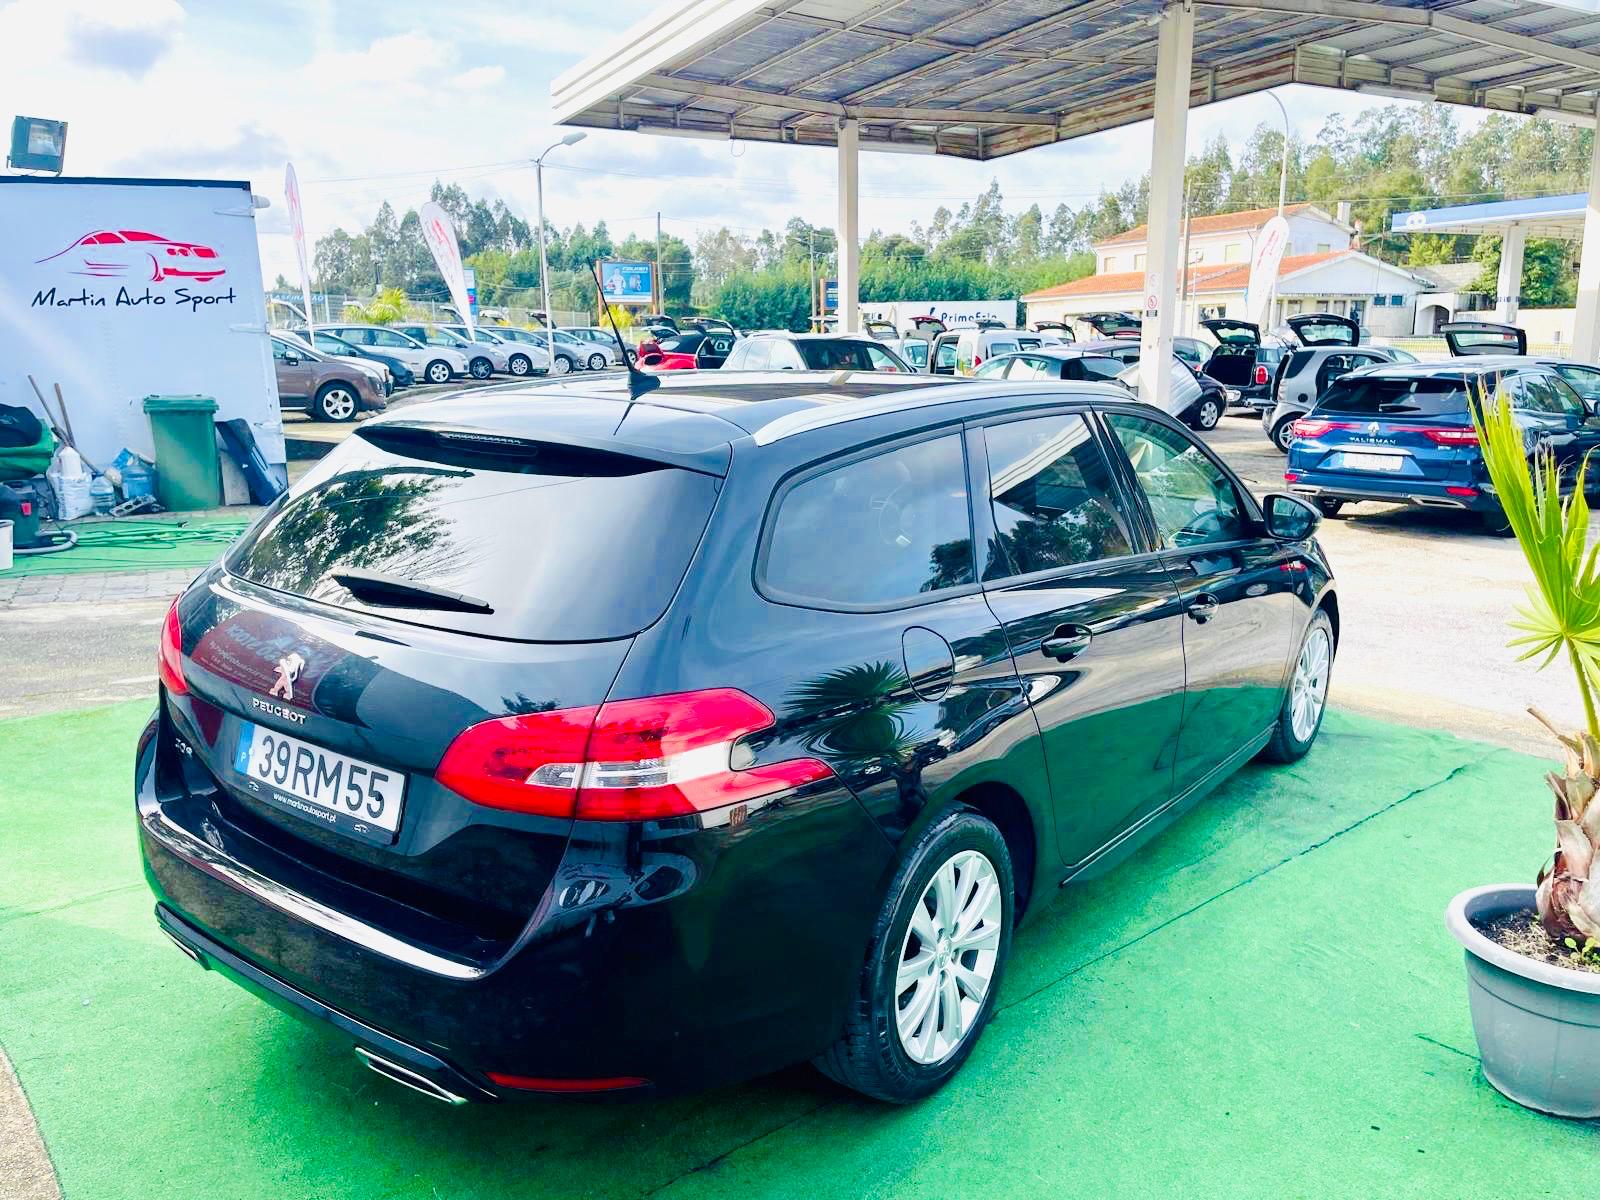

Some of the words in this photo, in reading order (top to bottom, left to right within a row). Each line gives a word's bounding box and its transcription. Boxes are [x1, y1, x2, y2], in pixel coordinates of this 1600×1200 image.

[32, 287, 105, 307] Martin
[115, 286, 166, 306] Auto
[174, 287, 236, 312] Sport
[1349, 436, 1396, 445] TALISMAN
[251, 697, 306, 725] PEUGEOT
[258, 735, 389, 819] 39RM55
